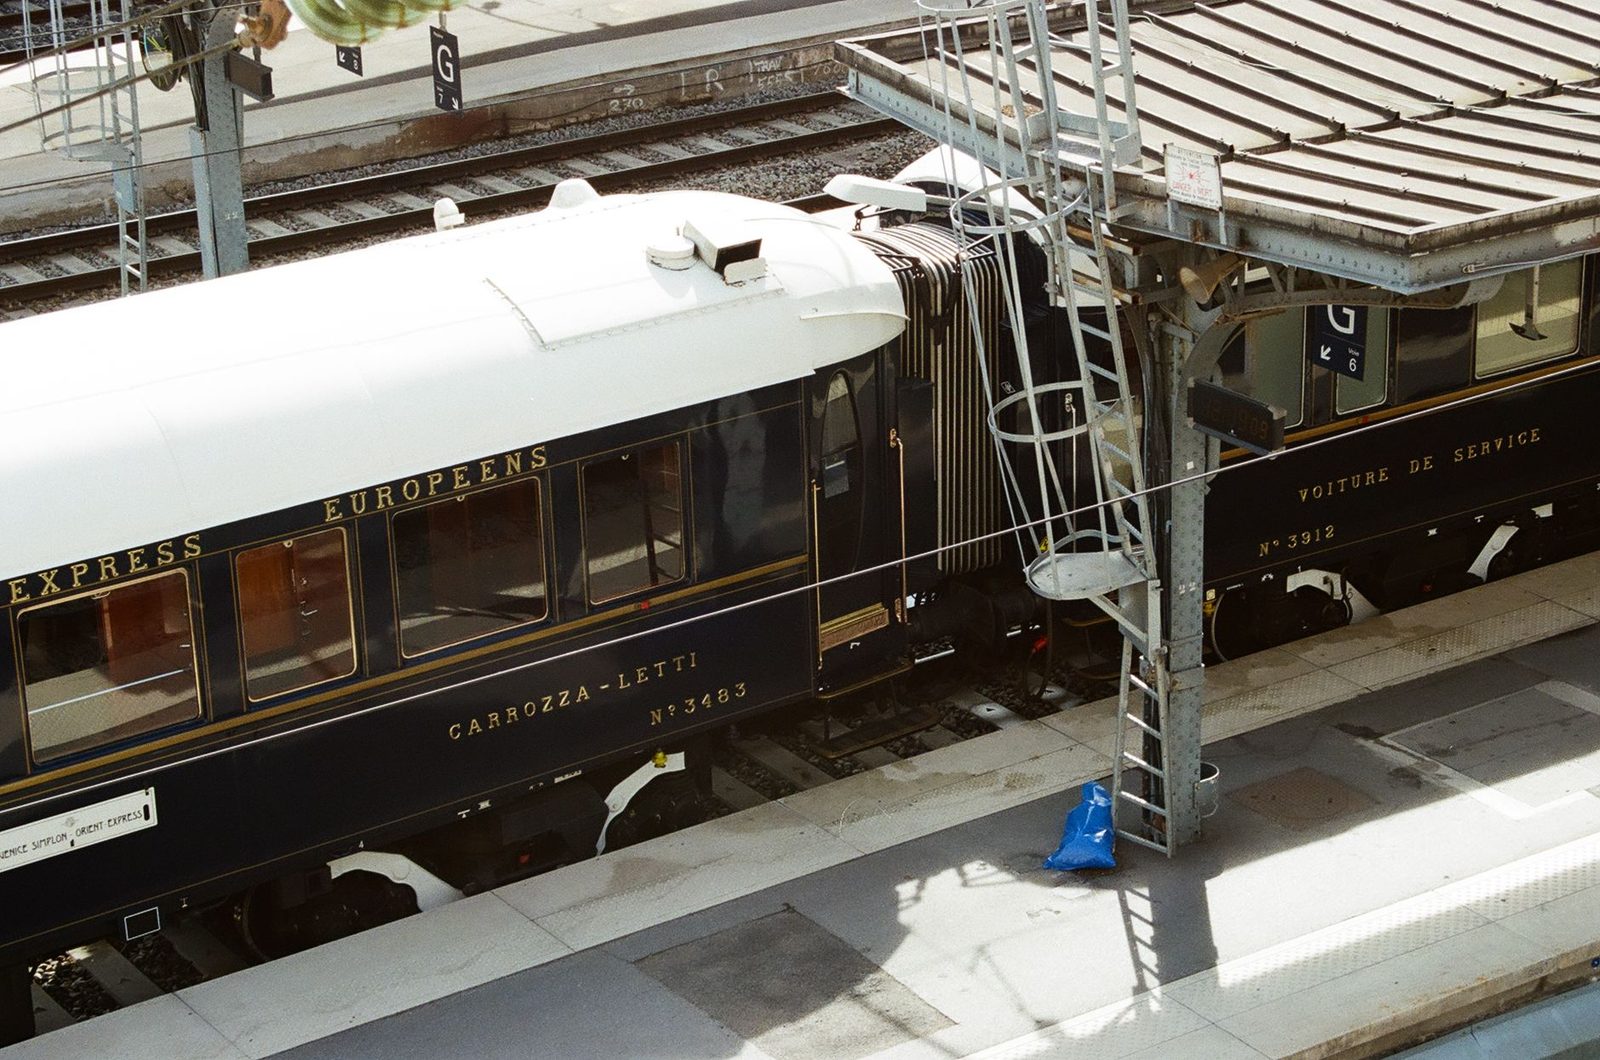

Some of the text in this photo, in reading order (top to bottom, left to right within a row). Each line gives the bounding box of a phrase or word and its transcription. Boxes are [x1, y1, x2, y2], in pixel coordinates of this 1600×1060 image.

[437, 44, 455, 83] G
[1327, 304, 1356, 335] G
[1349, 358, 1357, 372] 6
[1299, 428, 1541, 503] VOITURE DE SERVICE
[324, 445, 547, 523] EUROPEENS
[1287, 525, 1335, 549] 3912
[8, 533, 202, 604] EXPRESS
[32, 832, 68, 851] SIMPLON
